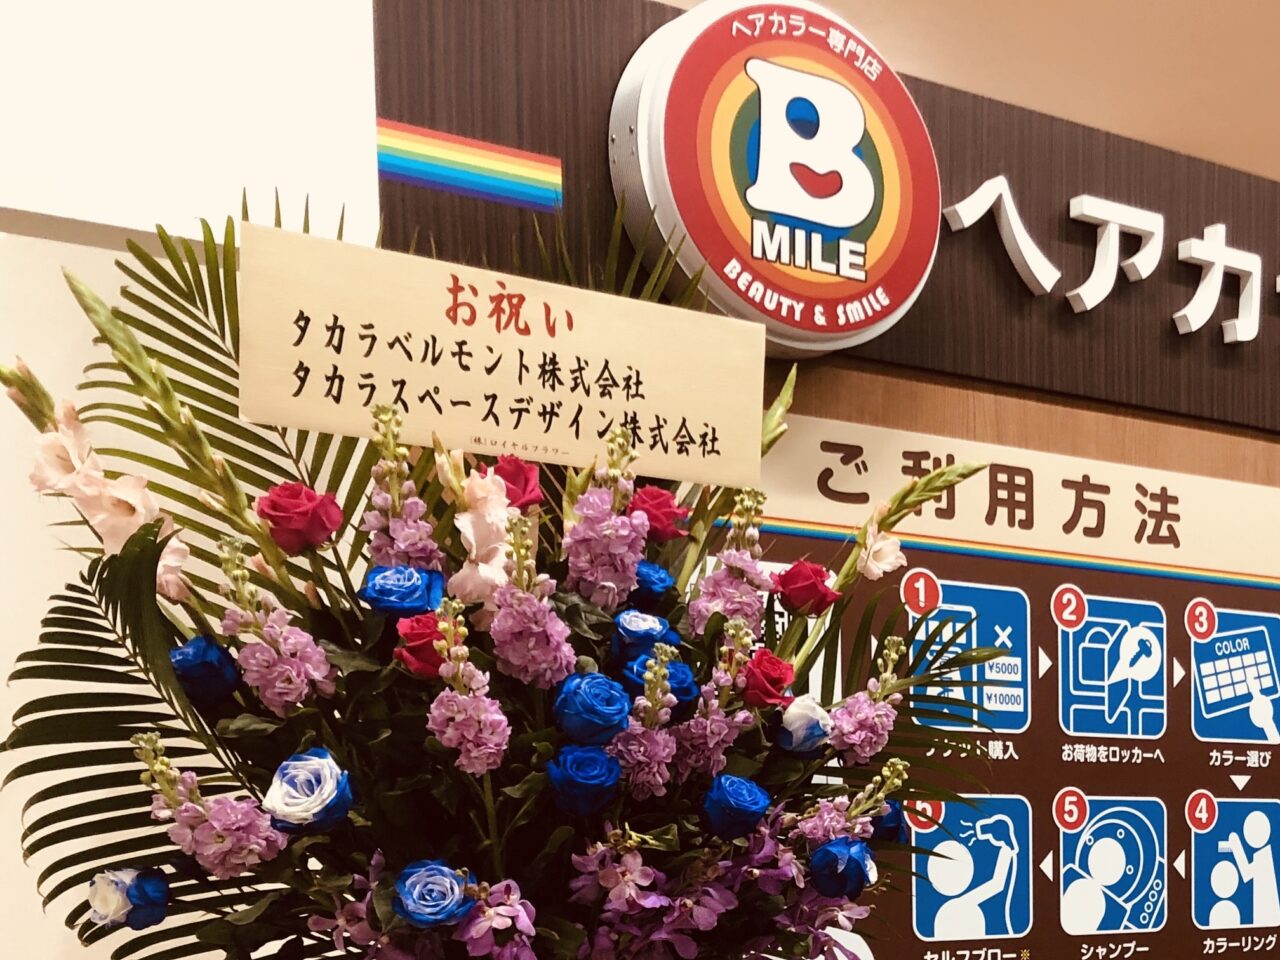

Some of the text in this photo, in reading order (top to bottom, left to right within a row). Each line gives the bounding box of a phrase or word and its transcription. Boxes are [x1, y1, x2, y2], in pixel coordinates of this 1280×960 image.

[731, 11, 883, 82] ヘアカラー専門店
[744, 57, 875, 228] B
[751, 217, 867, 282] MILE
[445, 273, 575, 339] お祝い
[723, 258, 890, 327] BEAUTY & SMILE
[292, 309, 646, 401] タカラベルモント株式会社
[292, 360, 722, 457] タカラスペースデザイン株式会社
[816, 440, 1182, 549] ご利用方法
[913, 577, 926, 607] 1
[1061, 592, 1078, 621] 2
[1194, 606, 1209, 633] 3
[1215, 637, 1250, 656] COLOR
[988, 662, 1019, 675] ¥5000
[986, 693, 1022, 706] ¥10000
[1061, 743, 1165, 764] お荷物をロッカーへ
[1209, 749, 1272, 768] カラー選び
[1062, 796, 1079, 823] 5
[1194, 797, 1209, 824] 4
[1080, 940, 1150, 960] シャンプー
[1202, 934, 1278, 954] カラーリング
